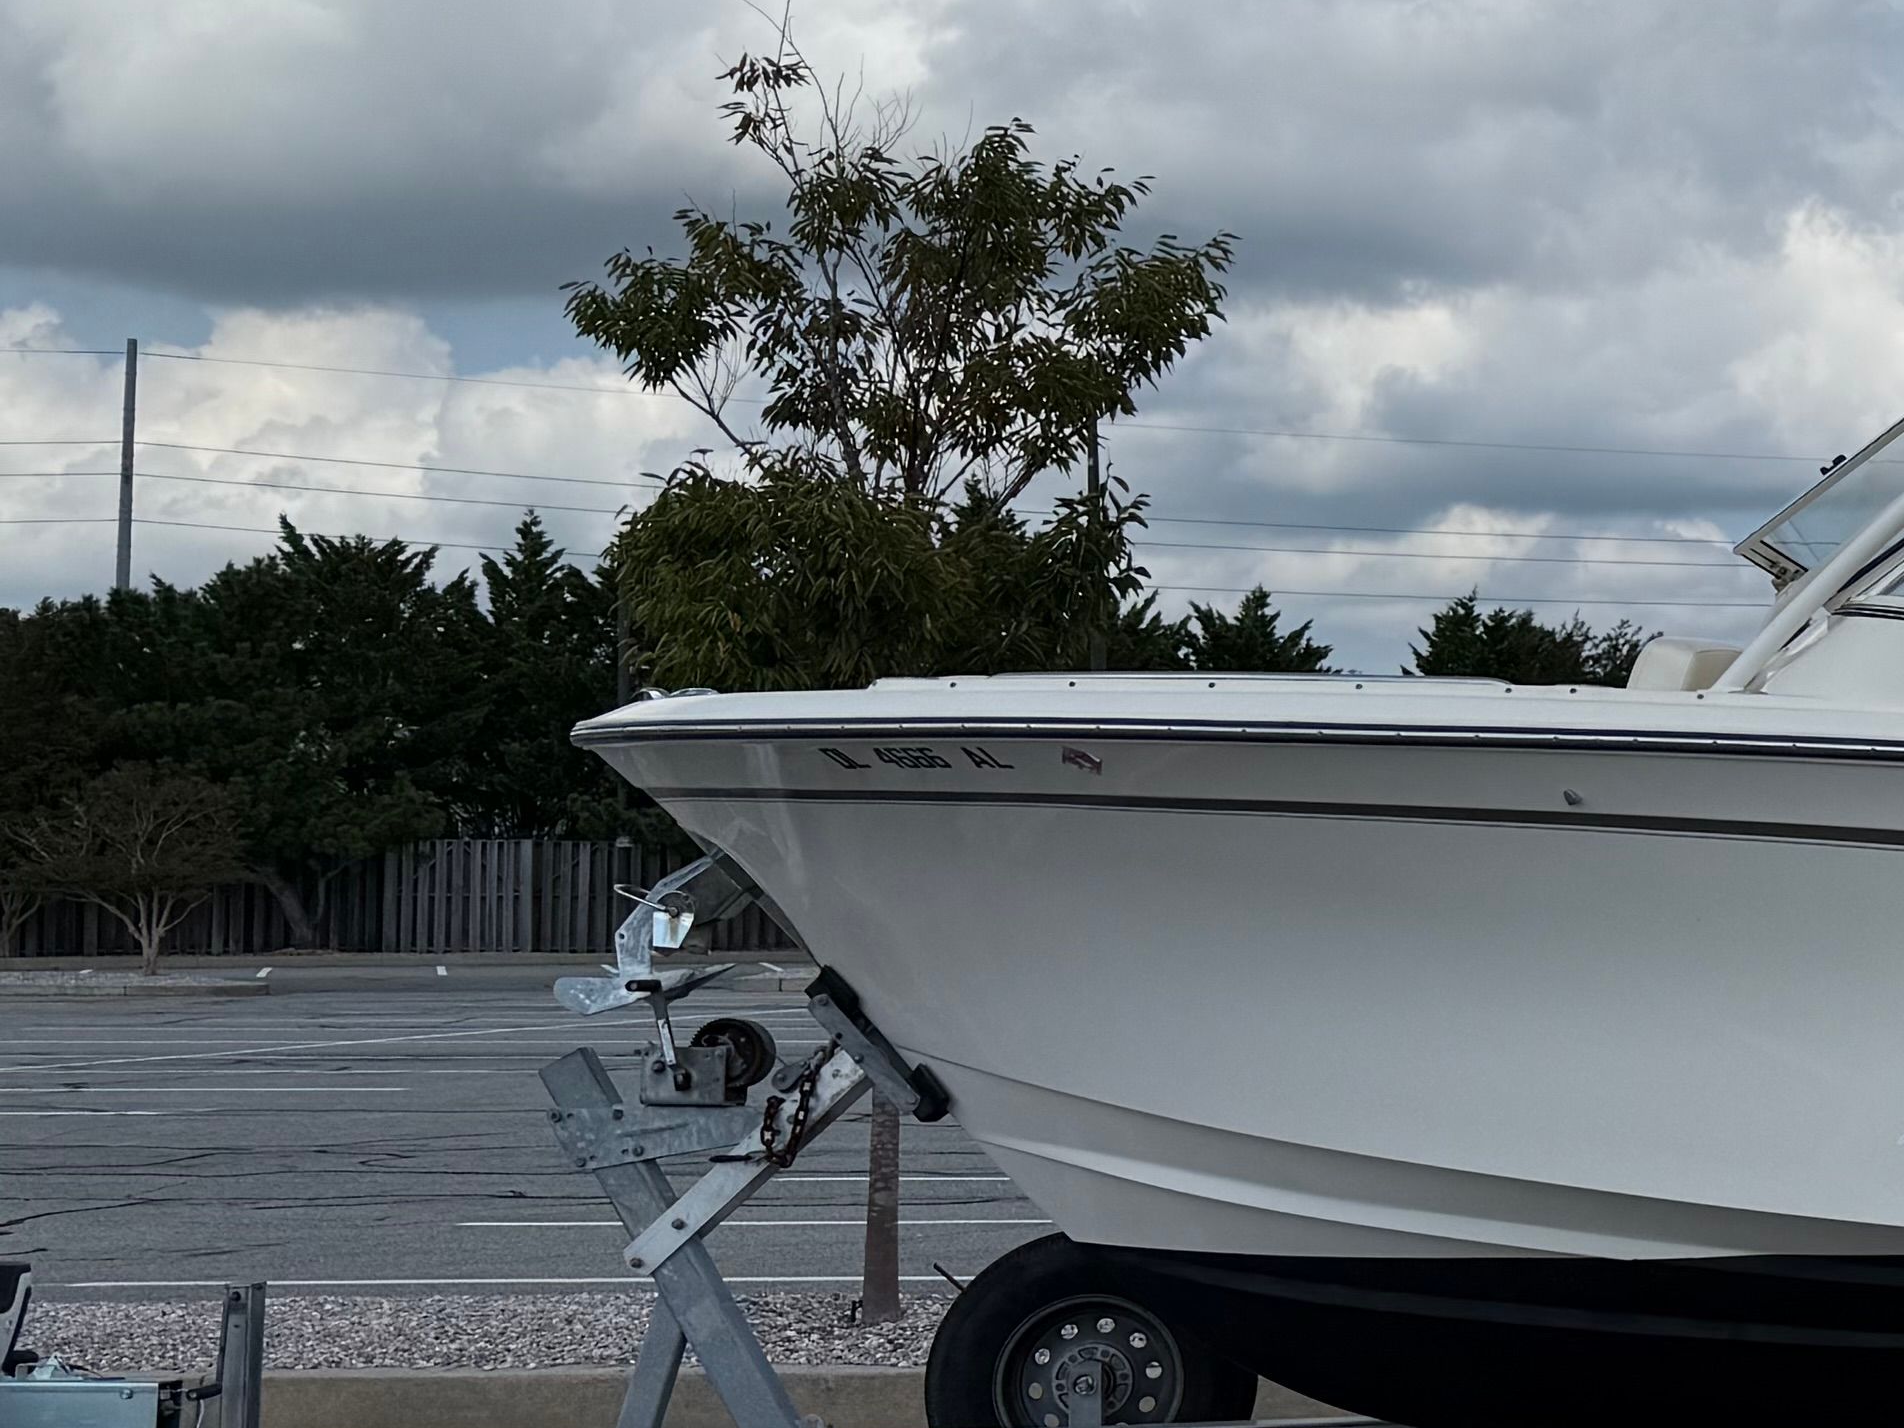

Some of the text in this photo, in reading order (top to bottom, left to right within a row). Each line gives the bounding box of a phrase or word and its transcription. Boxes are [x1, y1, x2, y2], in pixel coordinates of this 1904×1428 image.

[818, 746, 1015, 770] DL 4666 AL
